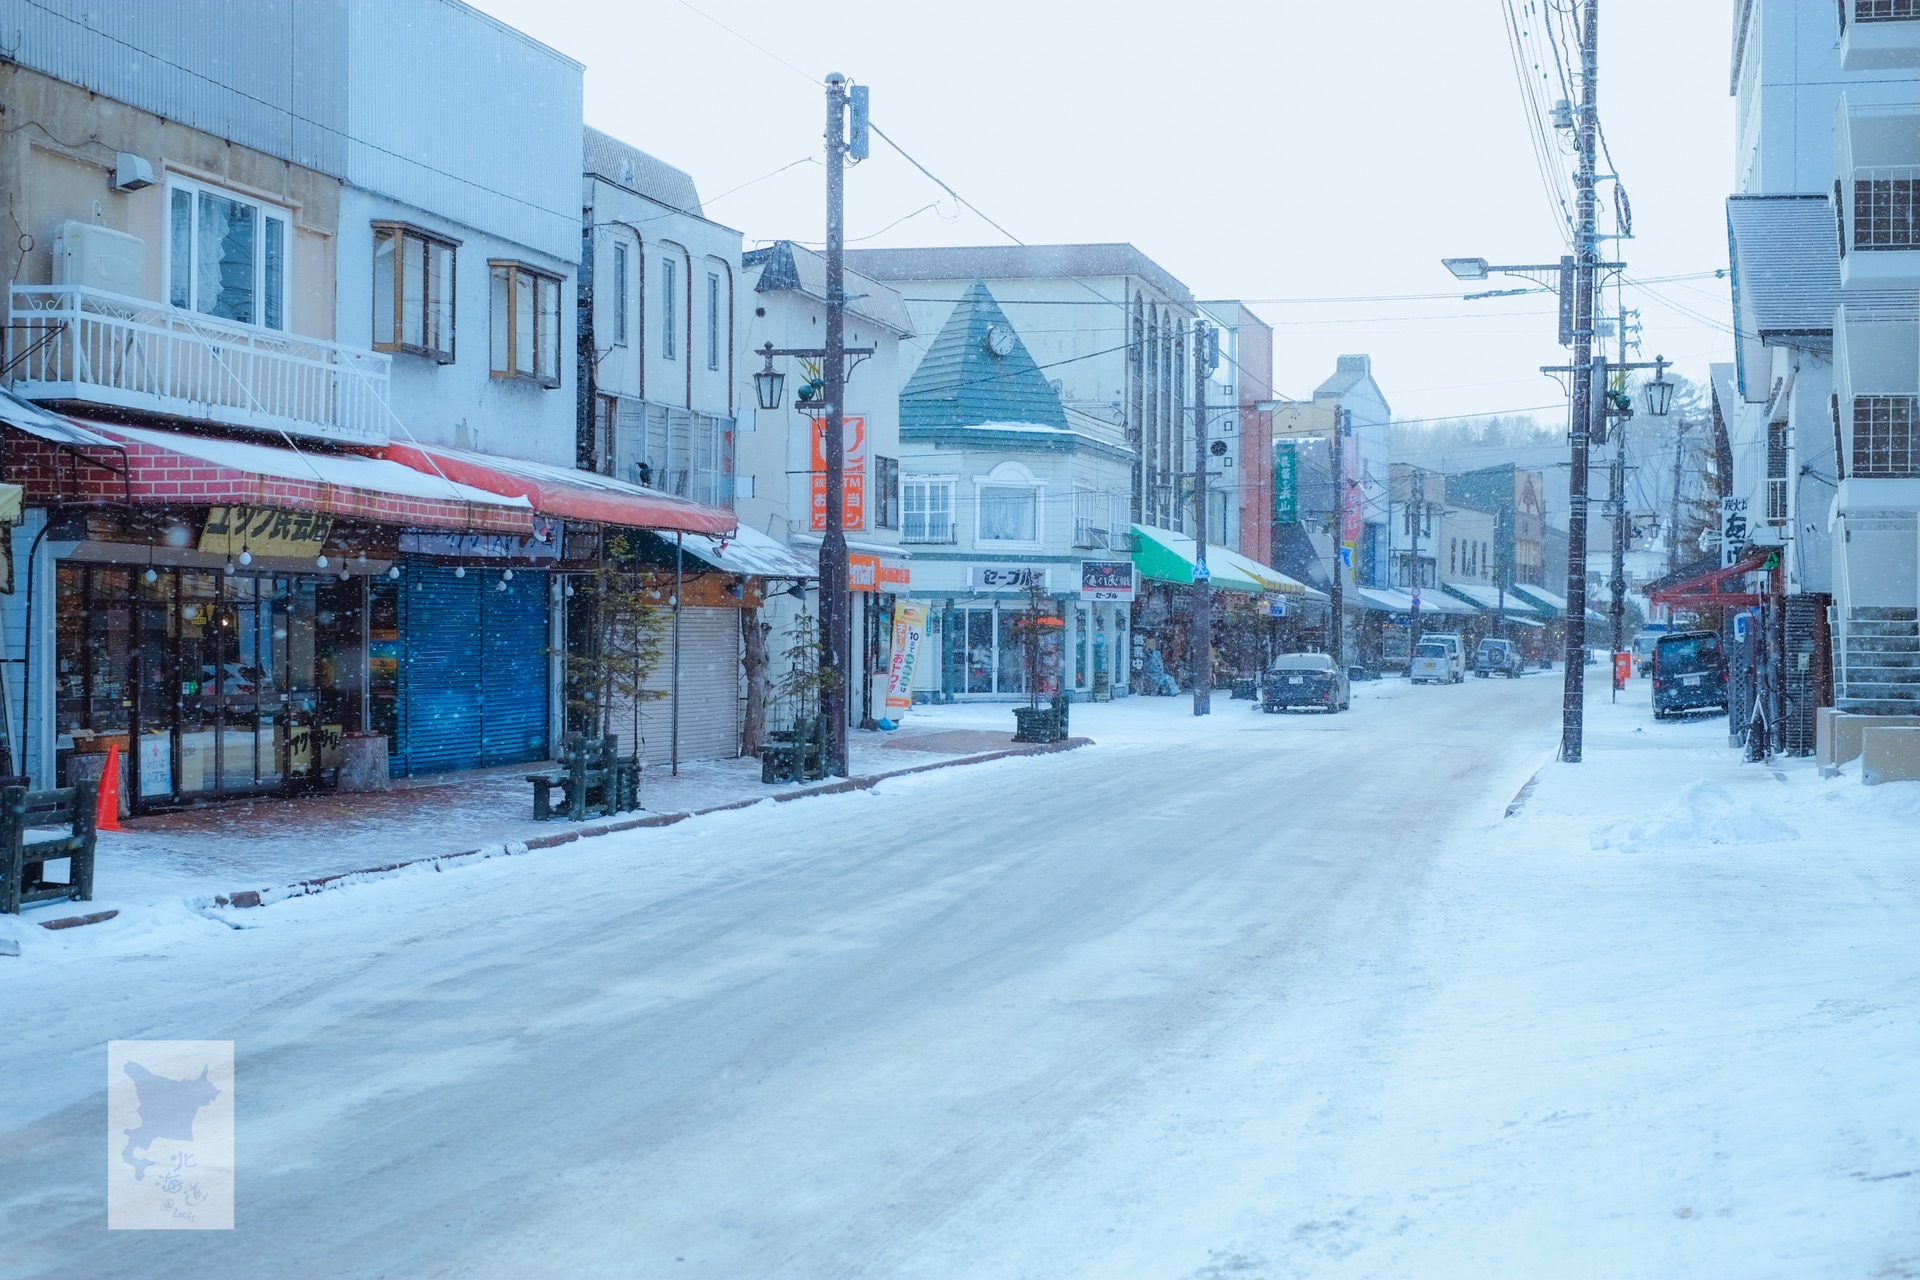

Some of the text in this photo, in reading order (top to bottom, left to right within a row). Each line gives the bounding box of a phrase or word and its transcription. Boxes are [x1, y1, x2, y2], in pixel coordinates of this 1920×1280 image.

[814, 493, 860, 508] お当
[815, 513, 860, 527] ワン
[984, 569, 1032, 586] セーブル
